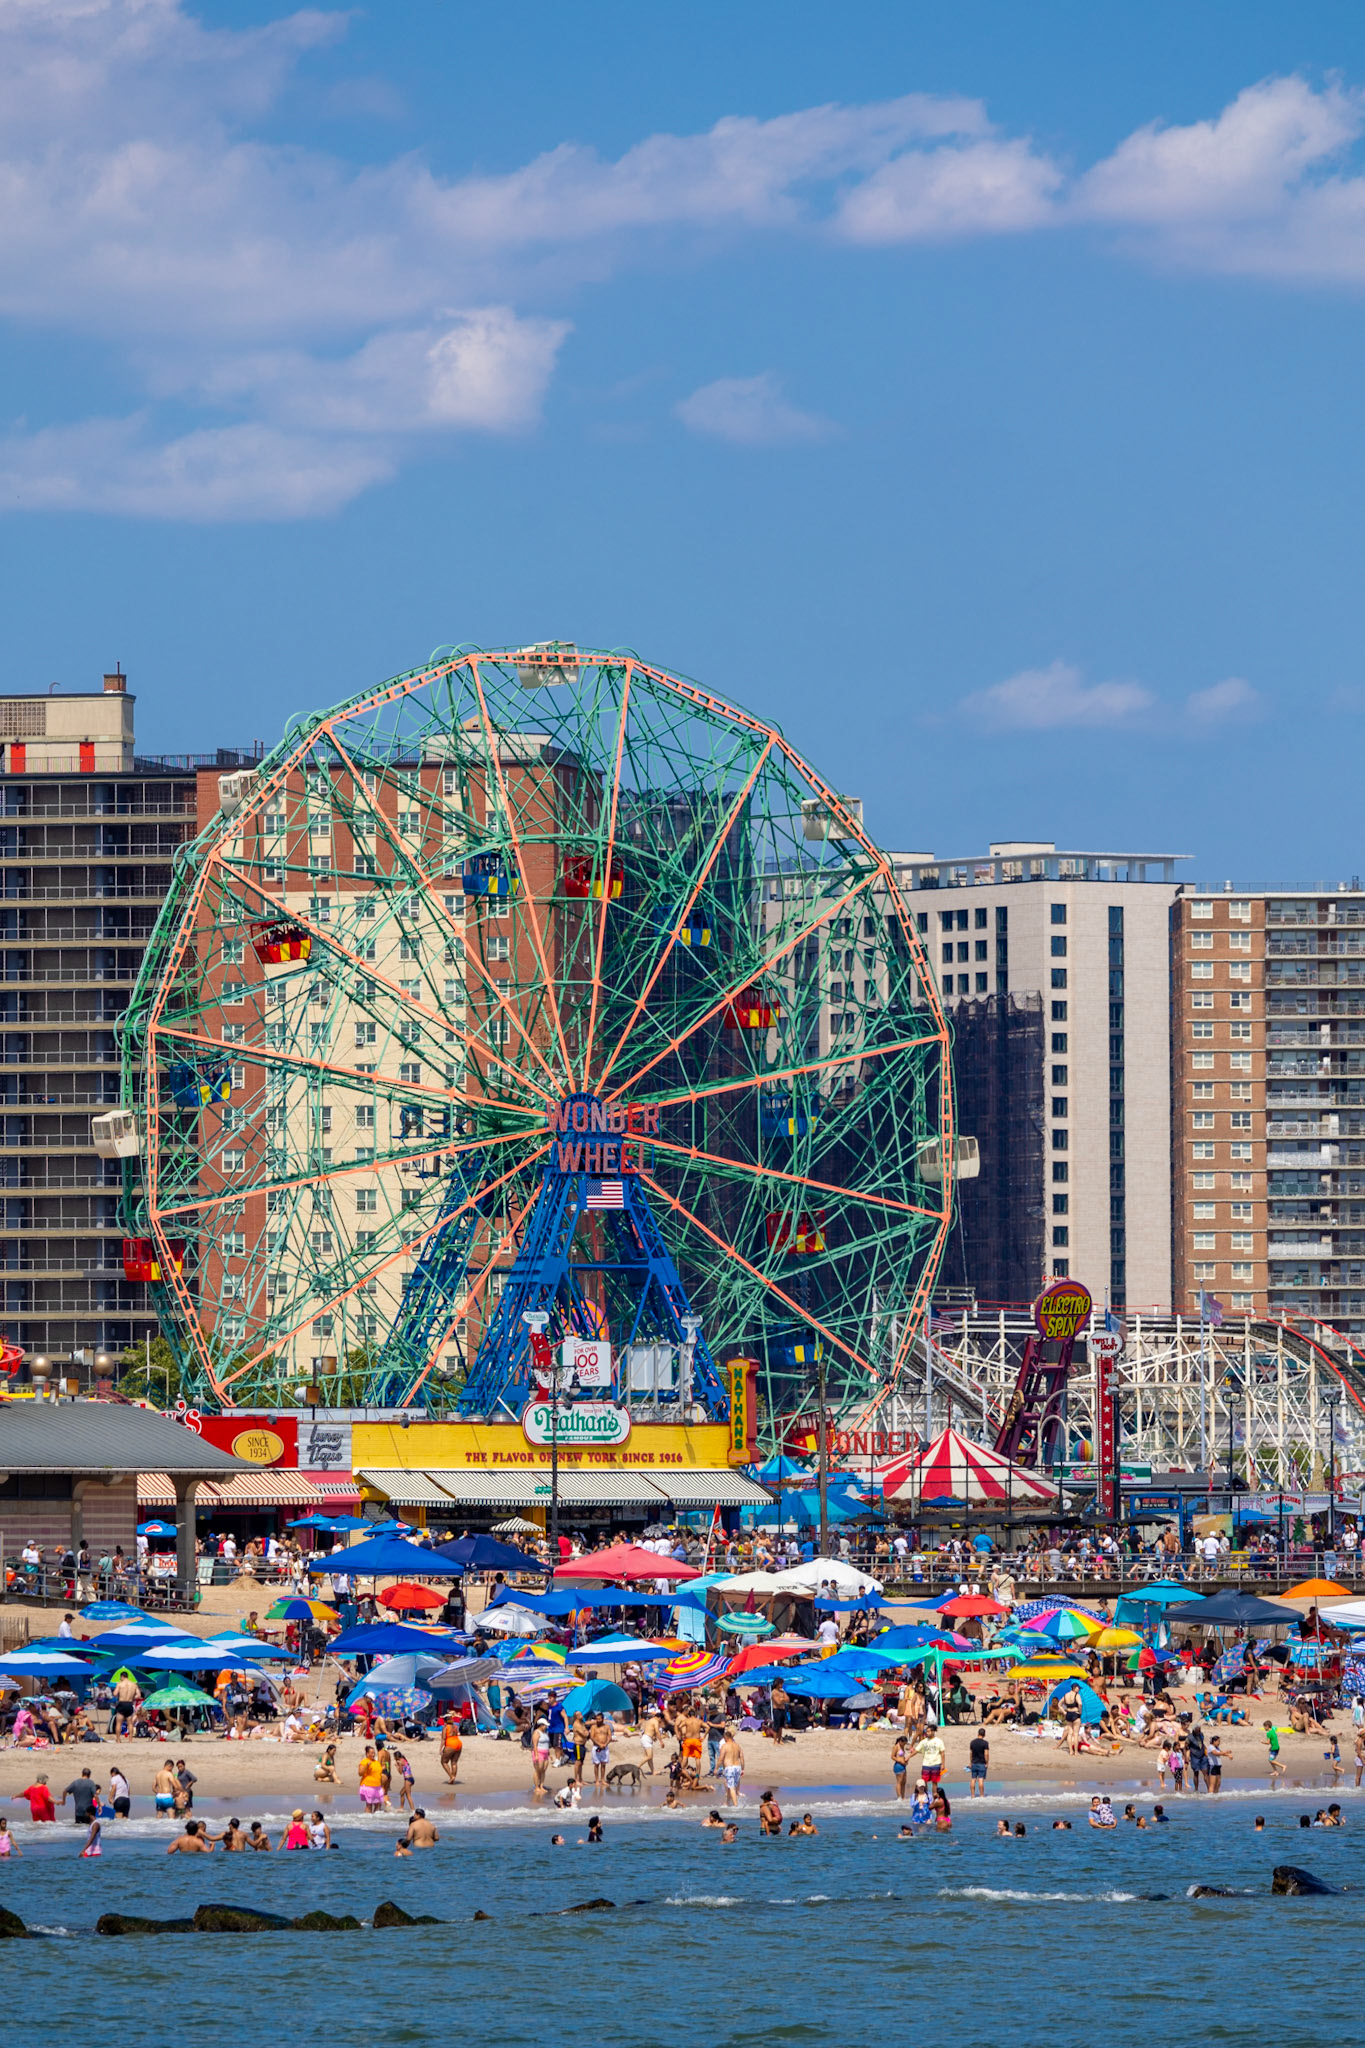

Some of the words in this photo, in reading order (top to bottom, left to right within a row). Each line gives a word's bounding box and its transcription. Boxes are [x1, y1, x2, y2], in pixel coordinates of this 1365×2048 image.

[546, 1101, 660, 1133] WONDER
[557, 1141, 654, 1174] WHEEL
[1040, 1295, 1091, 1315] ELECTRO
[1046, 1316, 1078, 1338] SPIN
[584, 1345, 598, 1353] OVER
[1091, 1337, 1109, 1345] TWIST
[574, 1352, 599, 1368] 100
[733, 1367, 744, 1450] NATHANS
[534, 1407, 622, 1437] Nathan's
[247, 1436, 269, 1448] SINCE
[249, 1447, 267, 1458] 1934
[465, 1452, 488, 1463] THE
[493, 1452, 534, 1463] FLAVOR
[557, 1452, 583, 1463] NEW
[587, 1452, 617, 1463] YORK
[622, 1452, 655, 1463] SINCE
[659, 1452, 683, 1463] 1916
